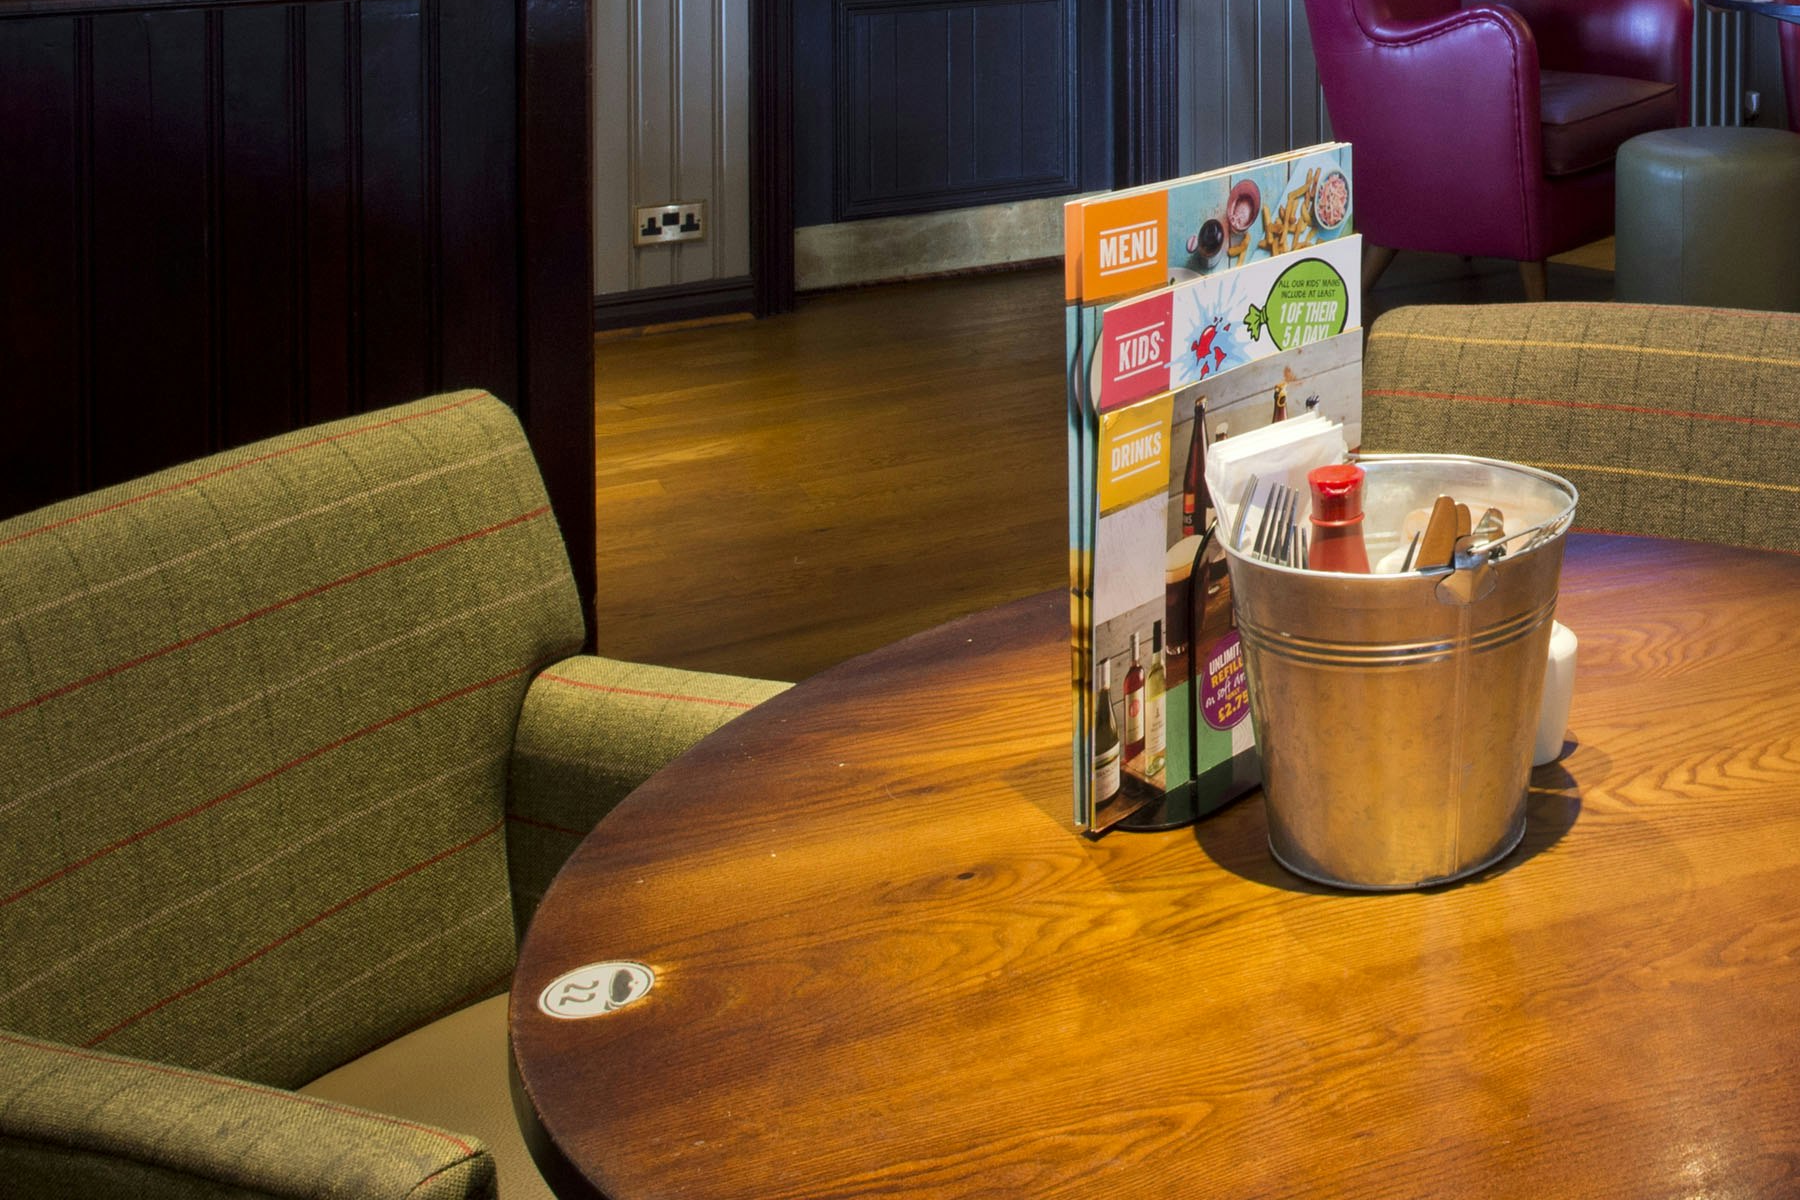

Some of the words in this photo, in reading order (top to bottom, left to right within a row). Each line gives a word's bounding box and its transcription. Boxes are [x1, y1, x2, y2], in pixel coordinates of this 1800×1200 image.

[1100, 227, 1158, 269] MENU
[1279, 280, 1290, 288] ALL
[1292, 280, 1304, 288] OUR
[1322, 279, 1341, 287] MAINS
[1281, 290, 1306, 299] INCLUDE
[1308, 290, 1317, 298] AT
[1317, 289, 1336, 297] LEAST
[1280, 302, 1287, 324] 1
[1287, 302, 1305, 324] OF
[1305, 301, 1338, 323] THEIR
[1119, 331, 1161, 372] KIDS
[1282, 325, 1293, 348] 5
[1291, 325, 1301, 347] A
[1111, 432, 1162, 472] DRINKS
[1209, 641, 1242, 676] UNLIMIT
[1211, 656, 1244, 688] REFILL
[1218, 689, 1249, 722] £2.75
